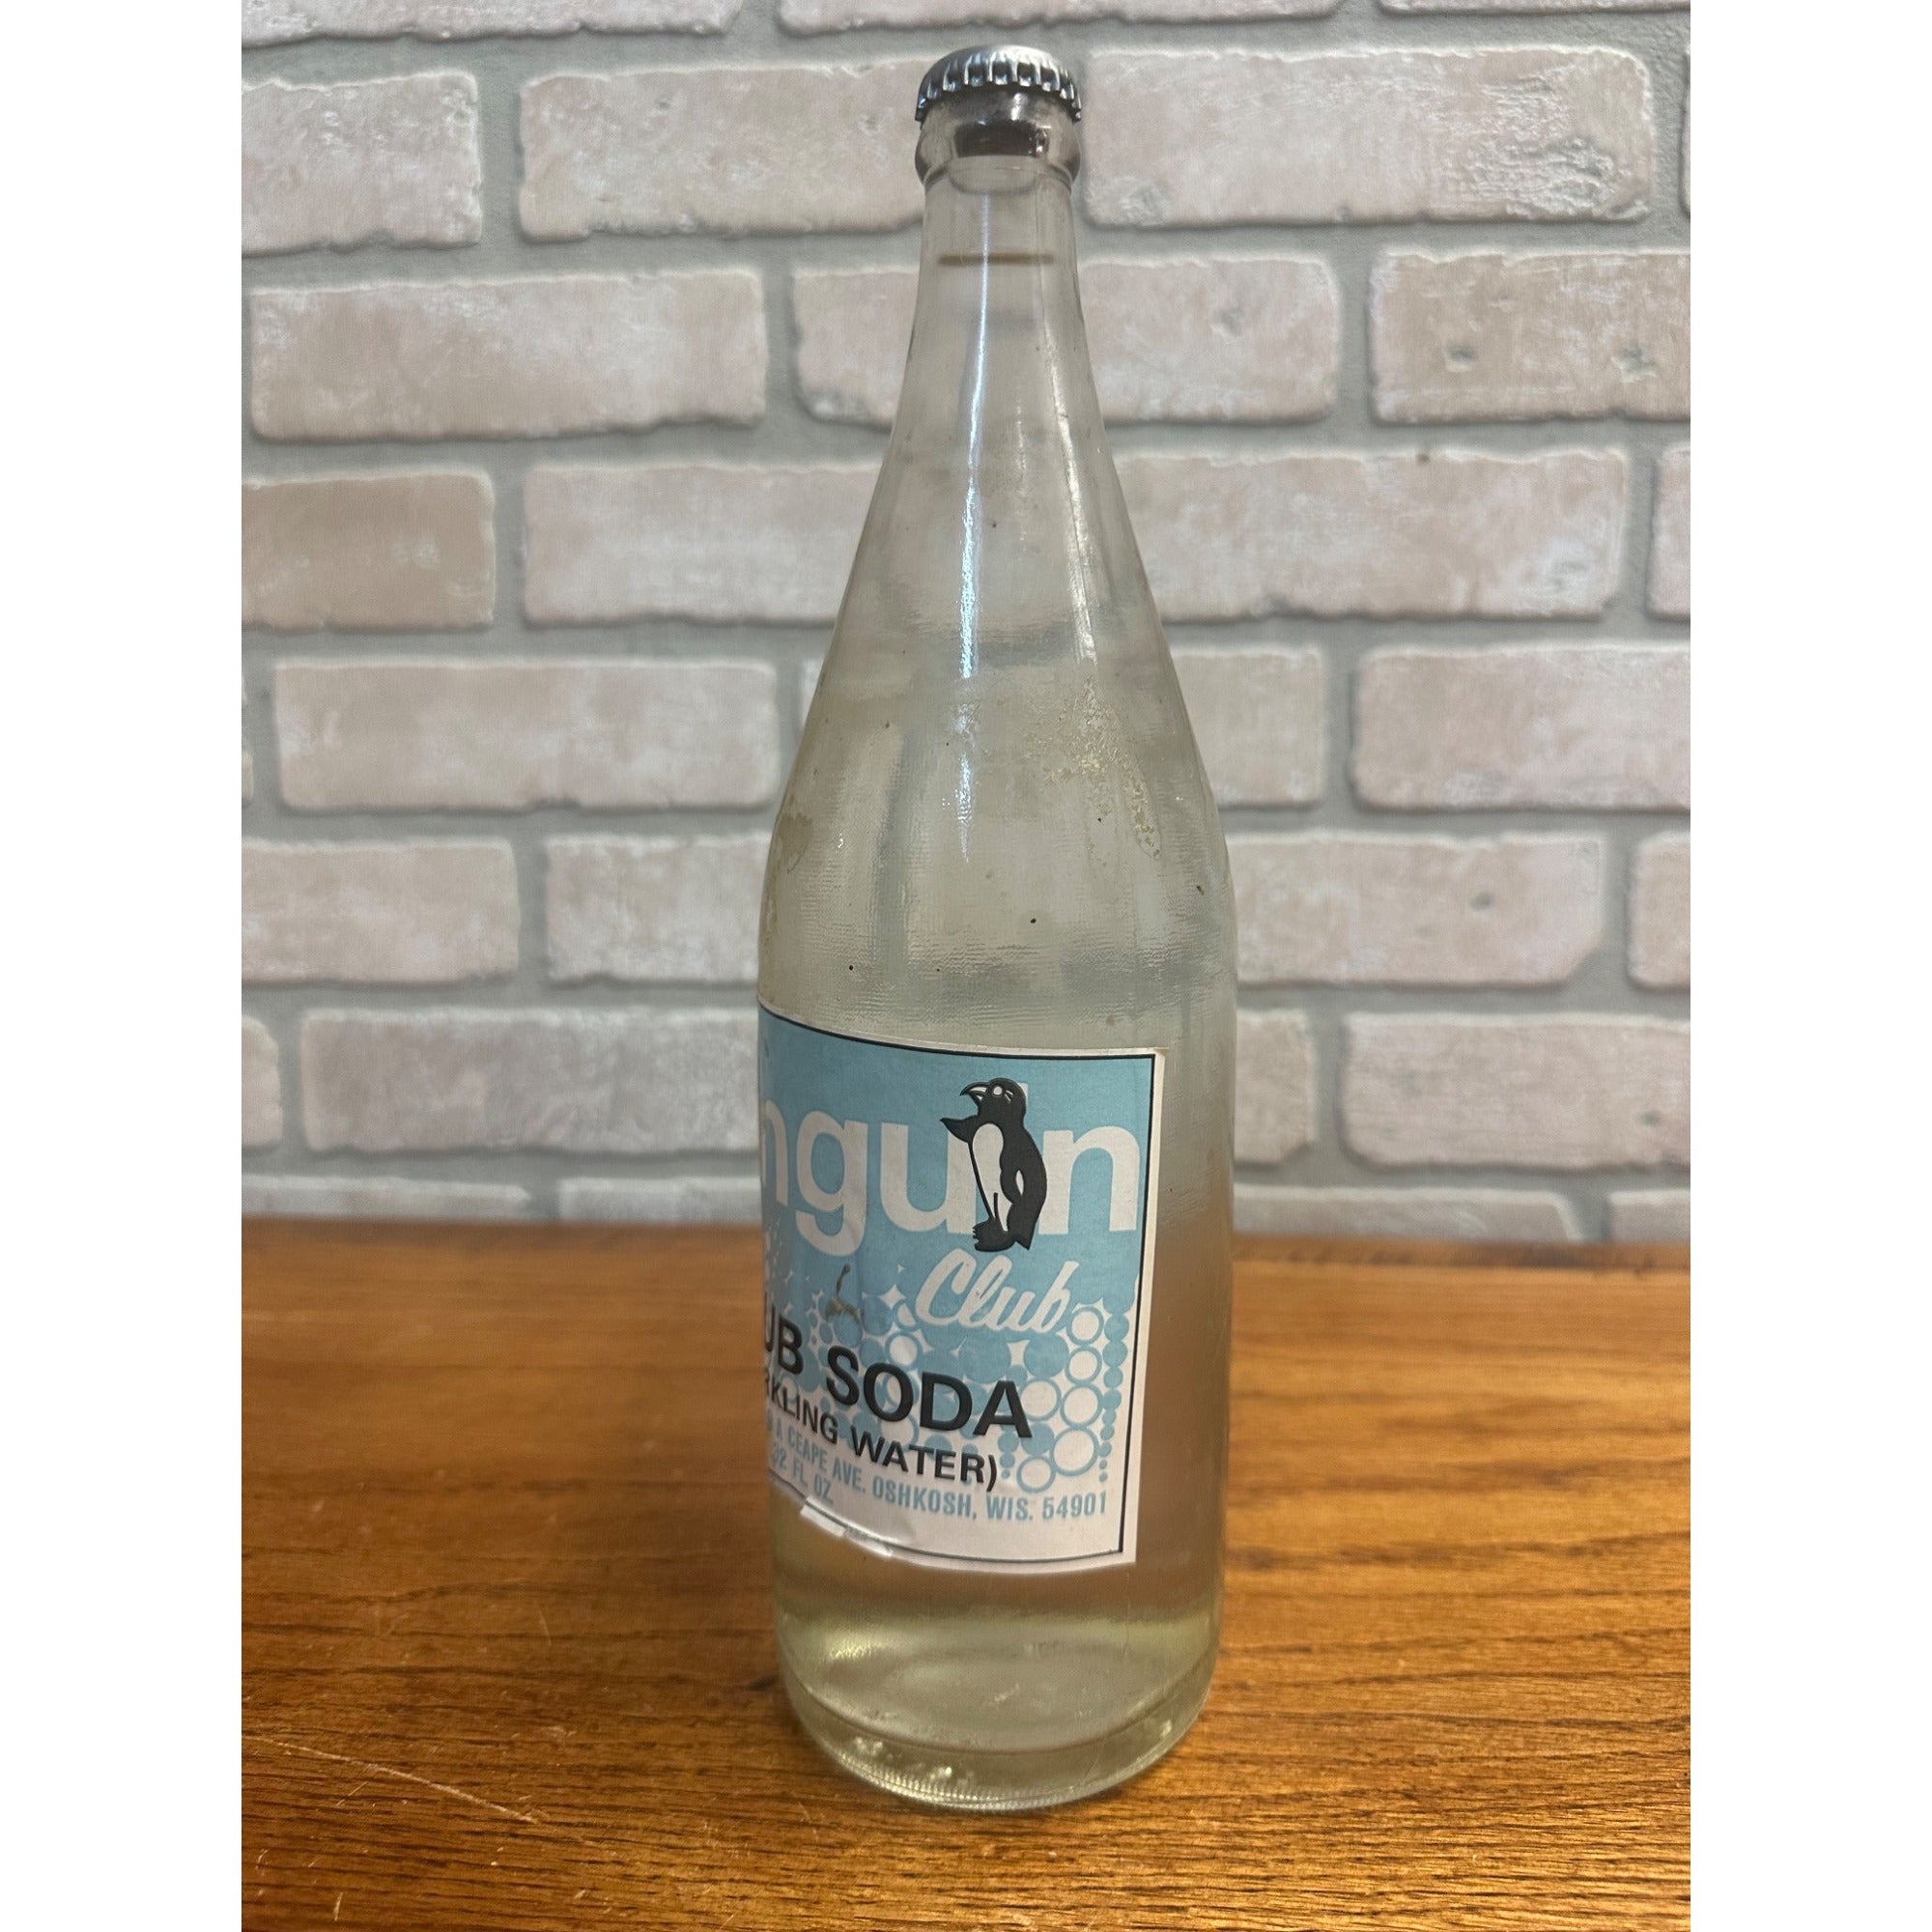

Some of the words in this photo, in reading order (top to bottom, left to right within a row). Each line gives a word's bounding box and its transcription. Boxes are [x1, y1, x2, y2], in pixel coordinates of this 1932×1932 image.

[760, 1083, 1140, 1257] ngun
[915, 1248, 1080, 1333] Club
[827, 1345, 1033, 1438] SODA
[787, 1425, 829, 1474] CEAPE
[832, 1456, 867, 1494] AVE.
[872, 1476, 977, 1521] OSHKOSH,
[986, 1496, 1034, 1521] WIS.
[1041, 1490, 1107, 1520] 54901
[851, 1424, 998, 1492] WATER)
